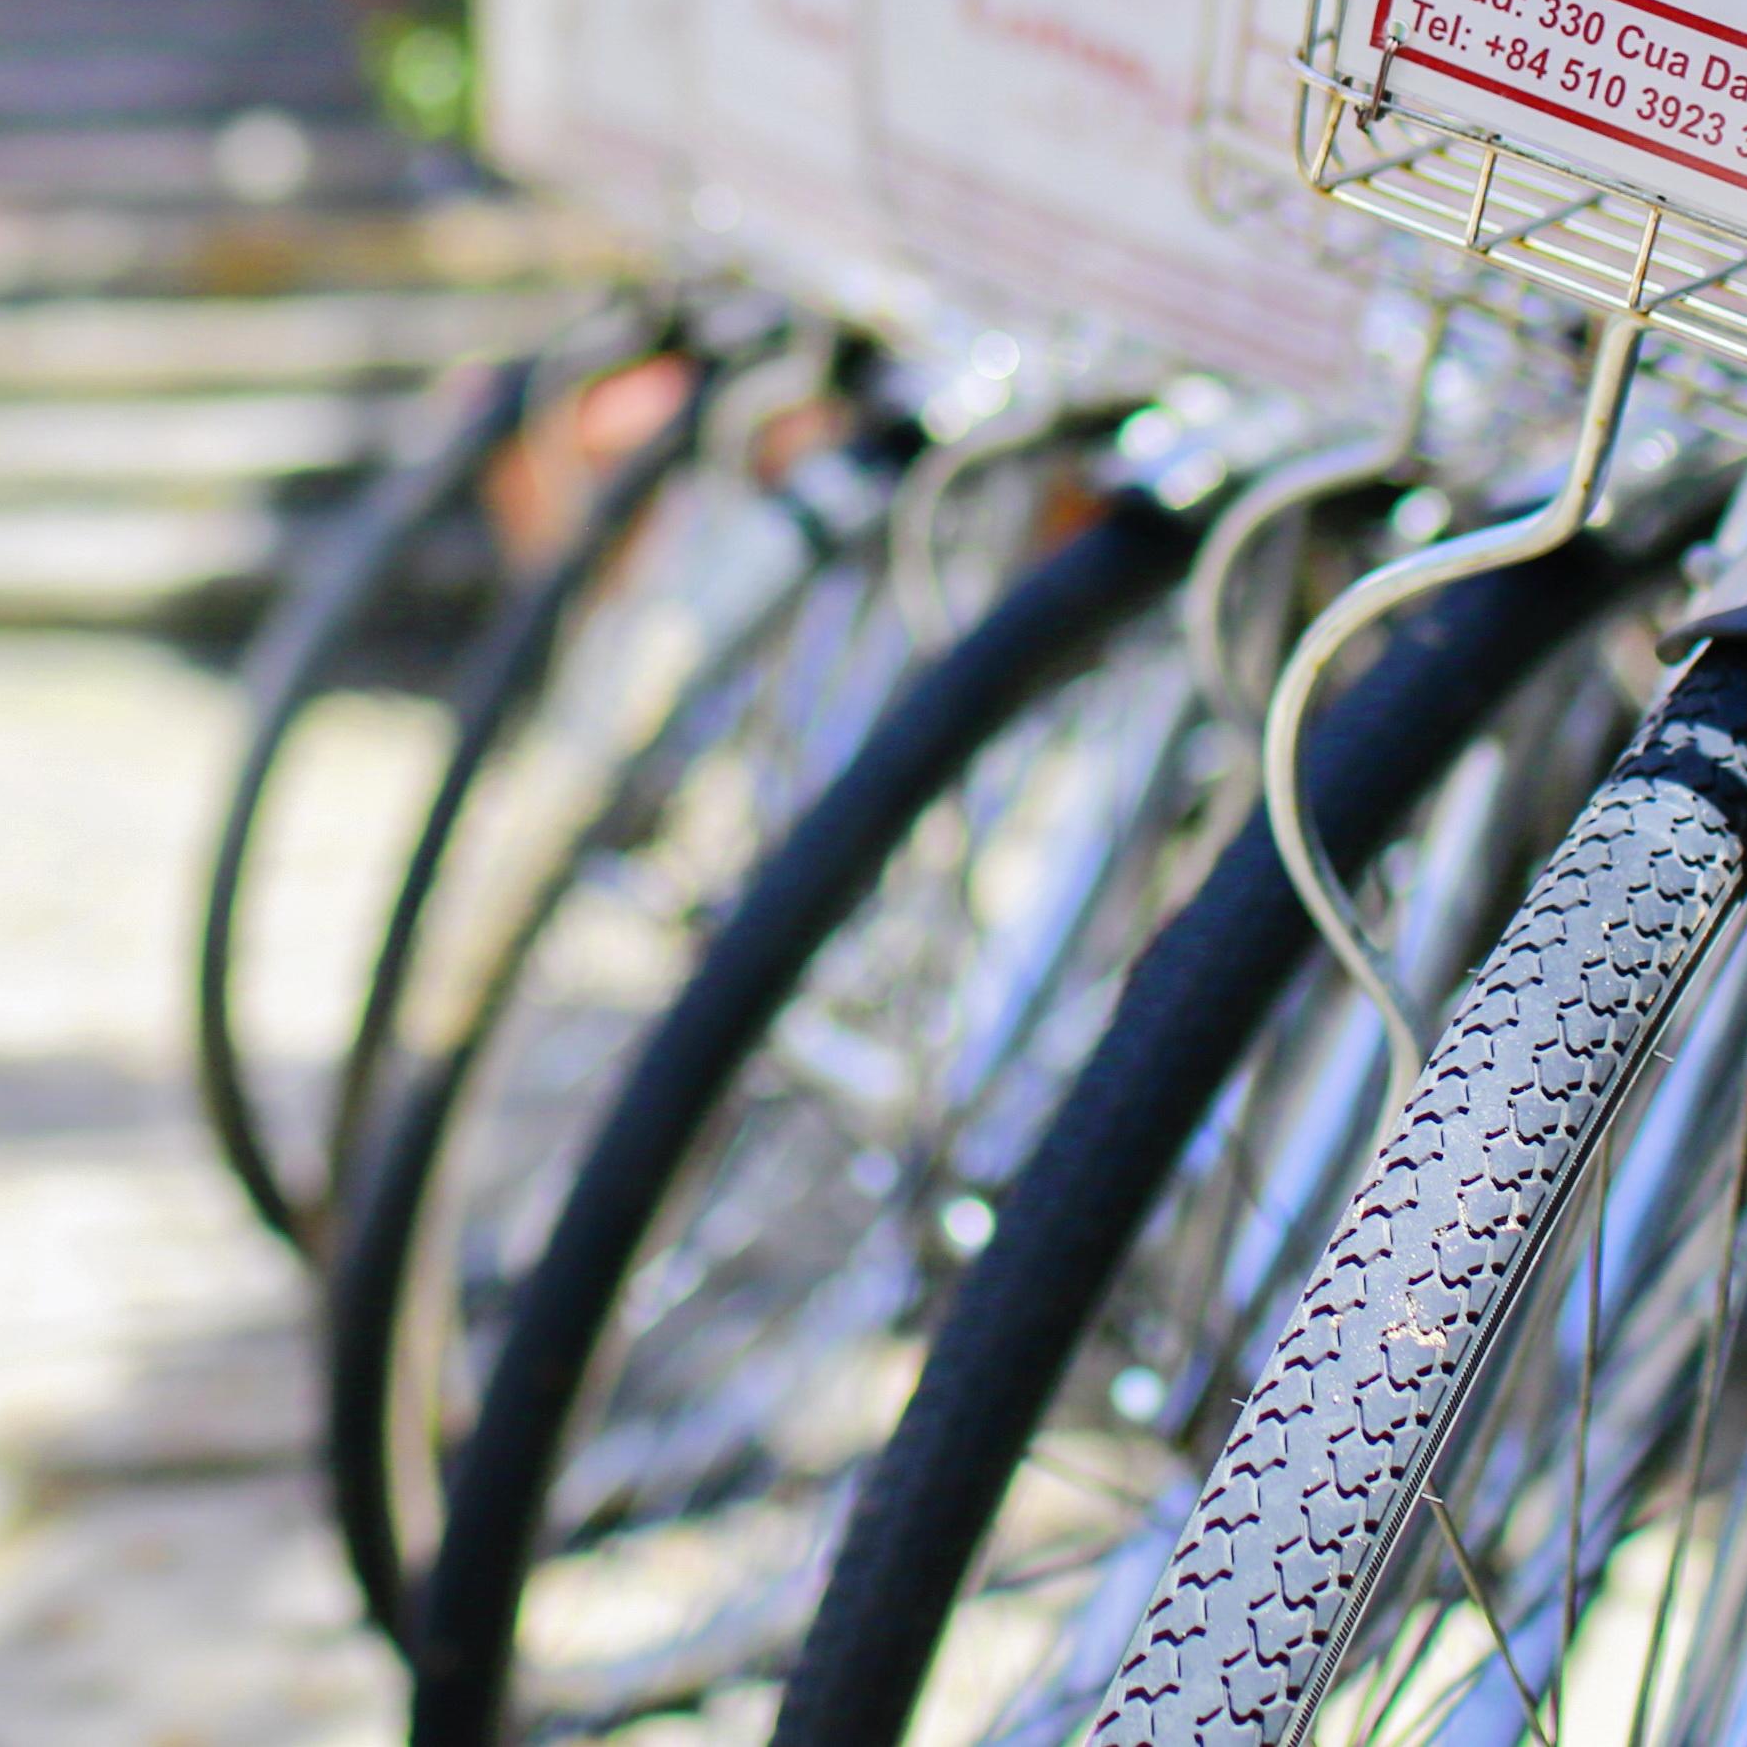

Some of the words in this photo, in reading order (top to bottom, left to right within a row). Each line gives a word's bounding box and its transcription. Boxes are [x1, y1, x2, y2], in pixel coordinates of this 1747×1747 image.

[1484, 34, 1549, 81] +84
[1559, 57, 1626, 109] 510
[1635, 86, 1725, 147] 3923
[1616, 24, 1690, 79] Cua
